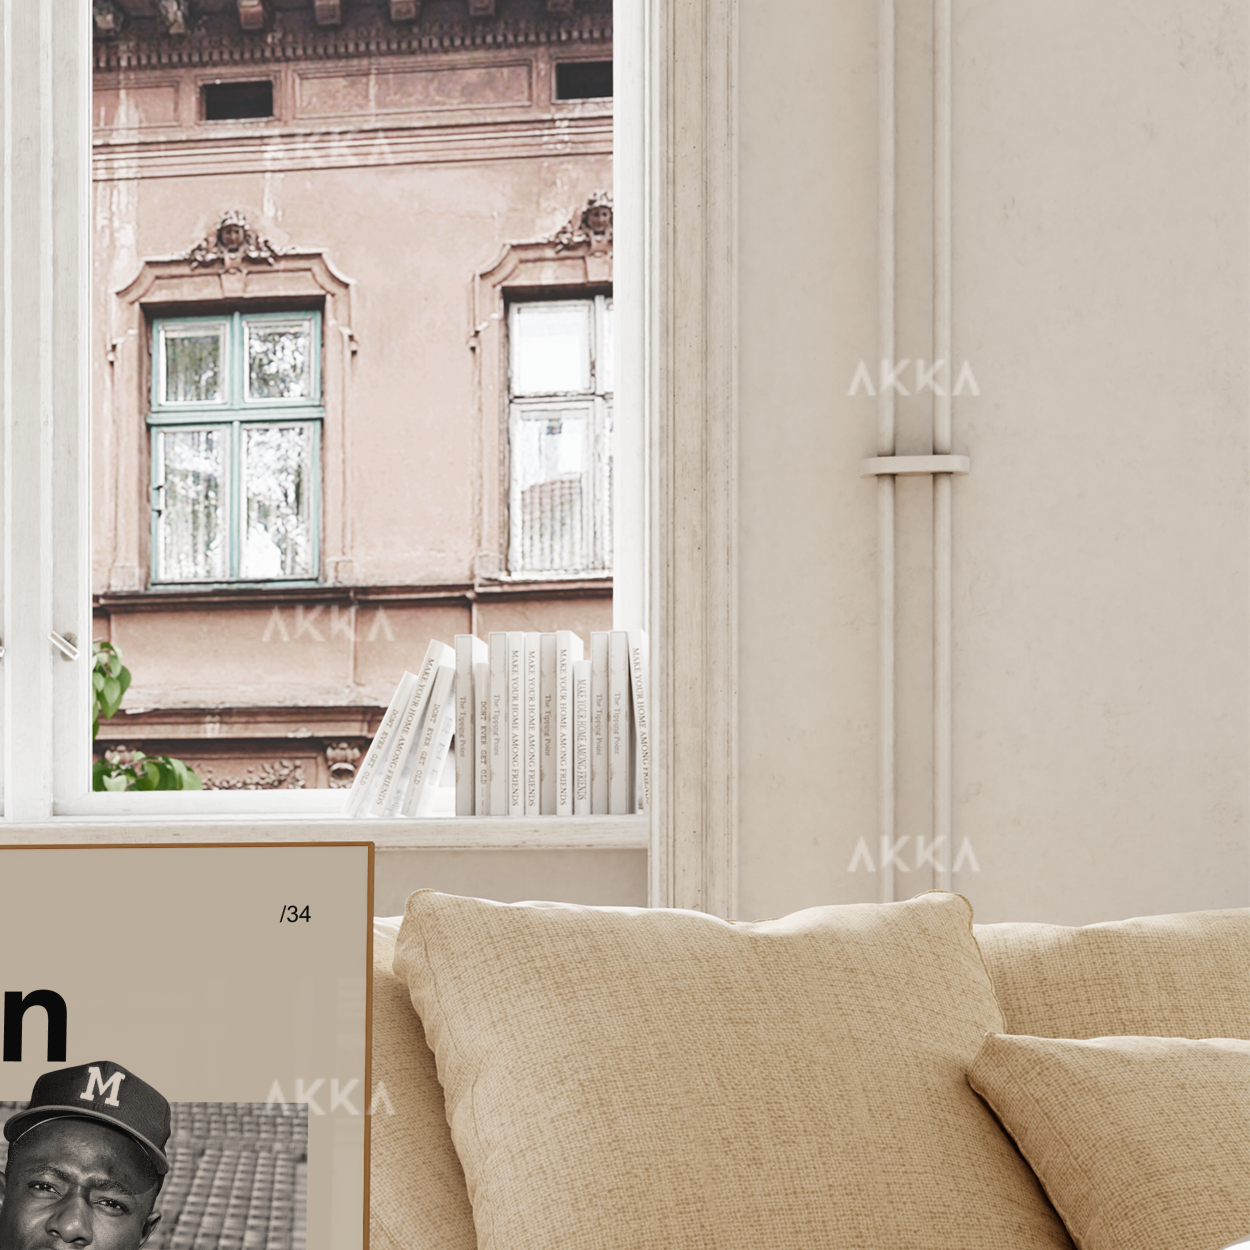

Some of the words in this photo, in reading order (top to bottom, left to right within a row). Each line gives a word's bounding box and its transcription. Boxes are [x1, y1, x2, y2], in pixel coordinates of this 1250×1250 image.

[421, 658, 435, 682] MAKE
[511, 649, 519, 674] MAKE
[559, 649, 567, 674] MAKE
[410, 684, 425, 708] YOUR
[511, 676, 519, 702] YOUR
[559, 676, 567, 701] YOUR
[401, 706, 417, 735] HOME
[480, 701, 488, 722] DONT
[511, 704, 519, 731] HOME
[543, 710, 552, 738] Tipping
[559, 703, 567, 730] HOME
[480, 726, 488, 746] EVER
[559, 732, 567, 766] AMONG
[390, 736, 406, 769] AMONG
[480, 749, 488, 765] GET
[511, 732, 519, 767] AMONG
[377, 770, 394, 806] FRIENDS
[480, 769, 488, 785] OLD
[511, 769, 519, 807] FRIENDS
[559, 768, 567, 805] FRIENDS
[280, 904, 311, 924] /34
[80, 1065, 127, 1107] M
